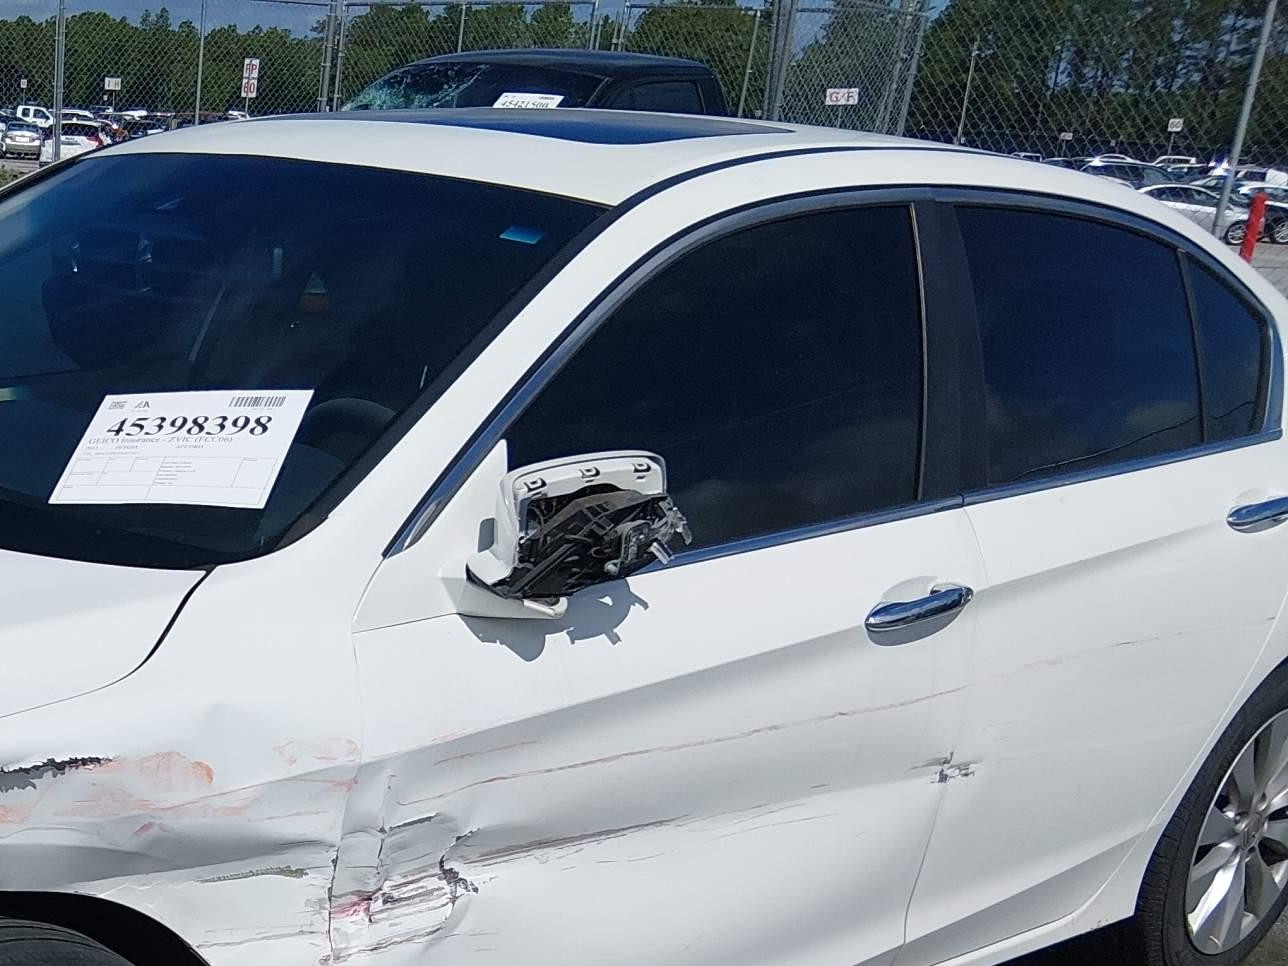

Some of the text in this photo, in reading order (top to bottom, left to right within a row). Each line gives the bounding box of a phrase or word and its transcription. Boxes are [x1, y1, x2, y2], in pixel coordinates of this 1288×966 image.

[106, 415, 273, 437] 45398398
[88, 437, 120, 445] GEICO
[120, 436, 161, 444] Insurance
